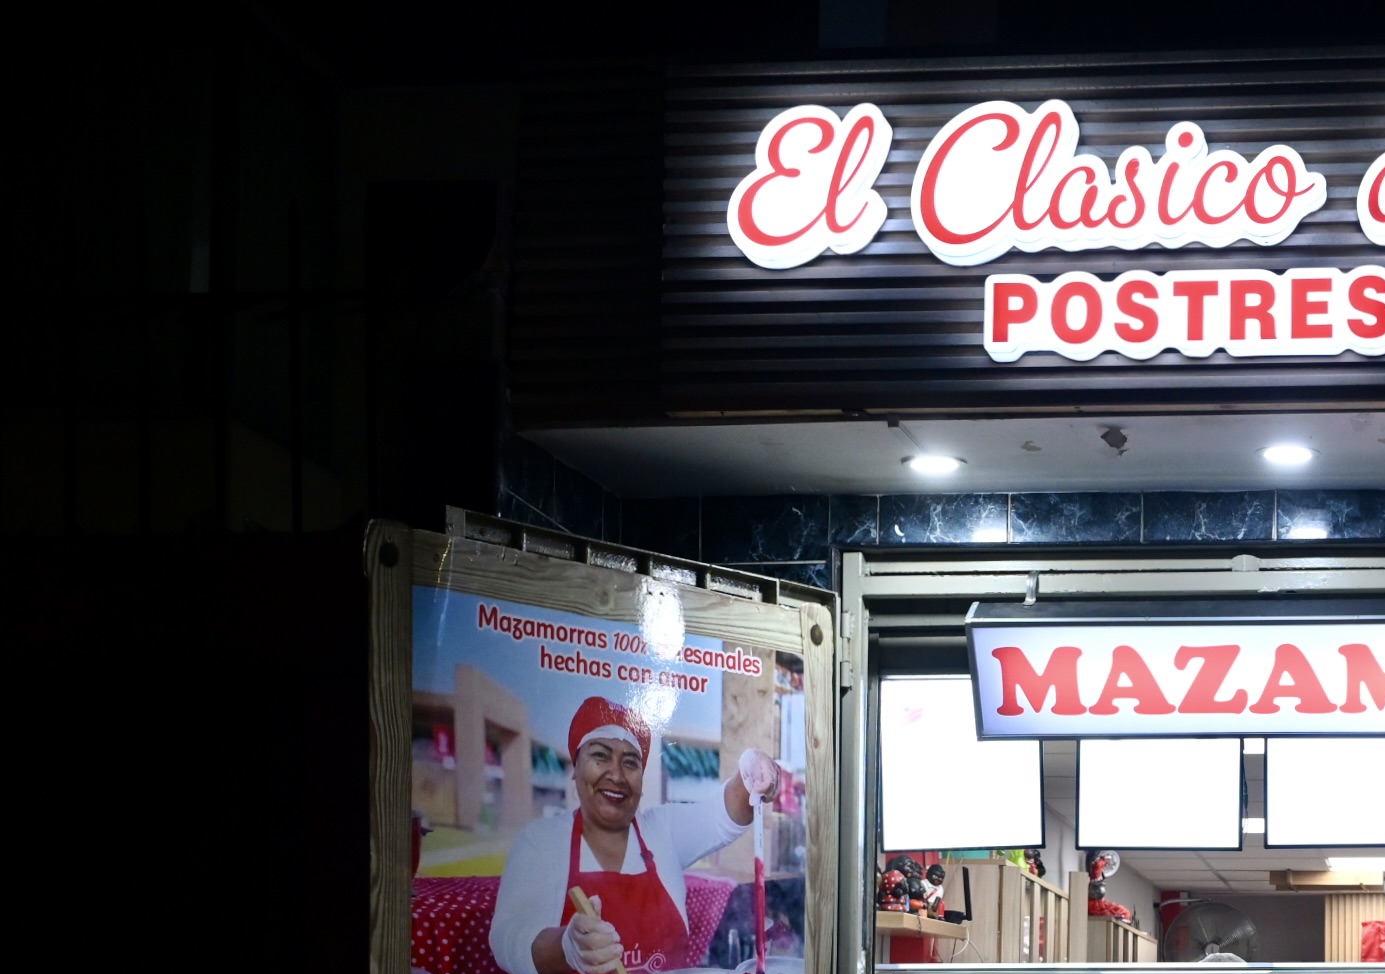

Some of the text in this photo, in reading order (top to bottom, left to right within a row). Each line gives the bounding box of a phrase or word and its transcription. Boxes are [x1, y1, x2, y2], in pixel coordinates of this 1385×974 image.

[737, 115, 875, 248] El
[919, 110, 1315, 245] Clasico
[478, 603, 608, 649] Mazamorras
[676, 645, 762, 675] esanales
[540, 645, 709, 693] hechas con amor
[623, 942, 642, 966] rú
